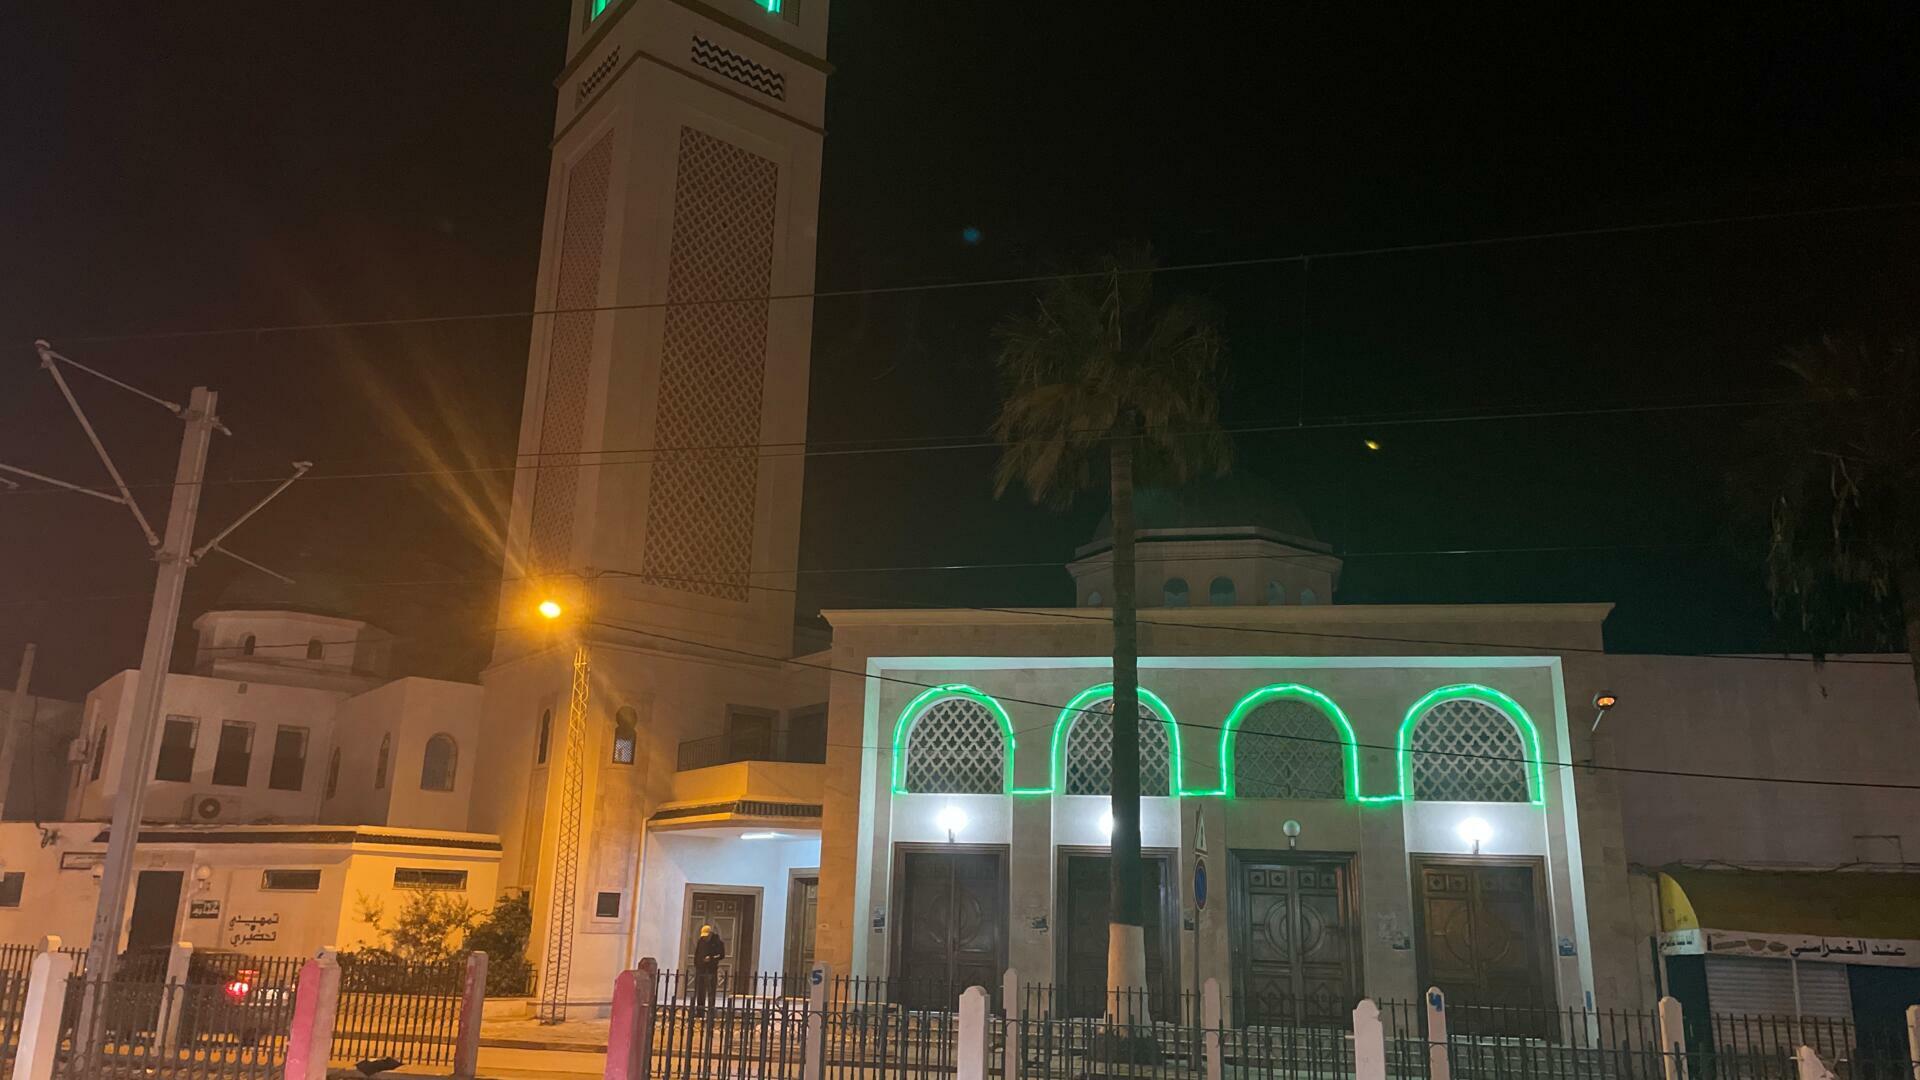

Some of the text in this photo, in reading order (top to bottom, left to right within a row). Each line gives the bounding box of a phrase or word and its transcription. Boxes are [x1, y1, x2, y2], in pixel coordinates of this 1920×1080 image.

[230, 929, 277, 947] تحضيري
[1871, 944, 1906, 956] عند
[812, 969, 823, 985] 5
